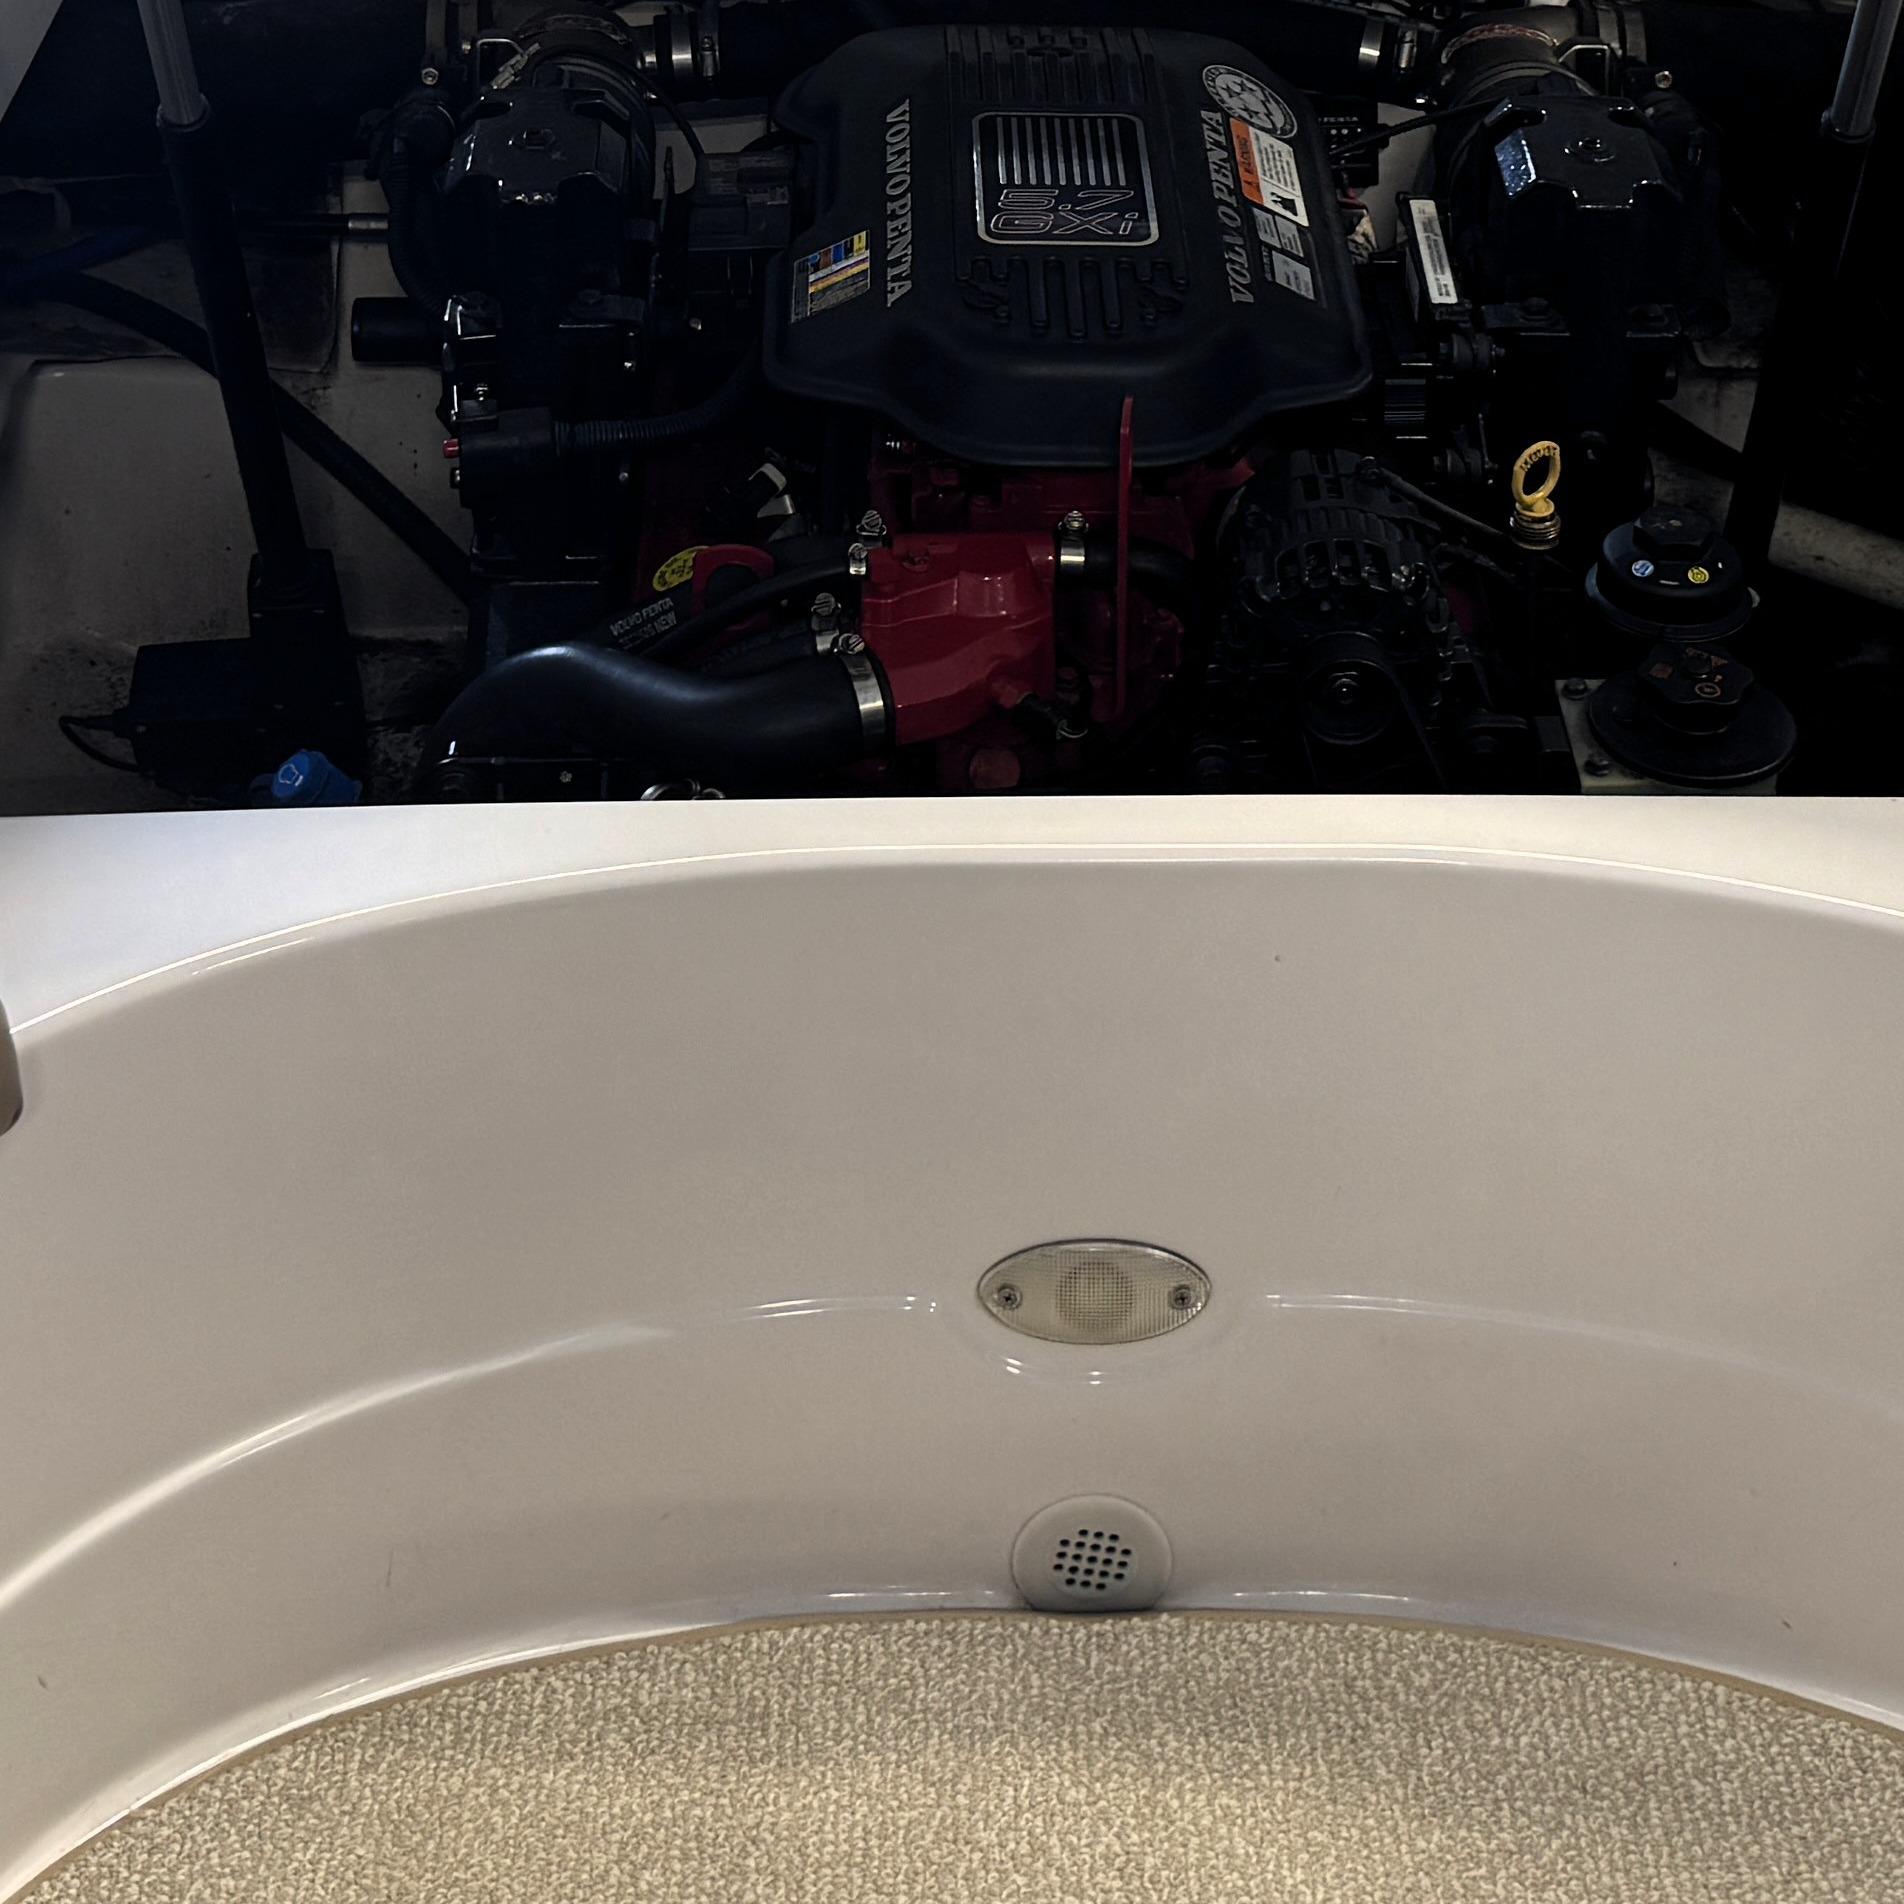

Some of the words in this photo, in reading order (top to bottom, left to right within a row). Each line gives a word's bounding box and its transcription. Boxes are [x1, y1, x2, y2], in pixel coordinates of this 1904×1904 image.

[885, 97, 912, 196] VOLVO
[1200, 109, 1239, 208] PENTA
[990, 210, 1140, 235] GXi
[997, 188, 1135, 211] 5.7
[886, 192, 913, 308] PENTA
[1216, 205, 1256, 303] VOLVO
